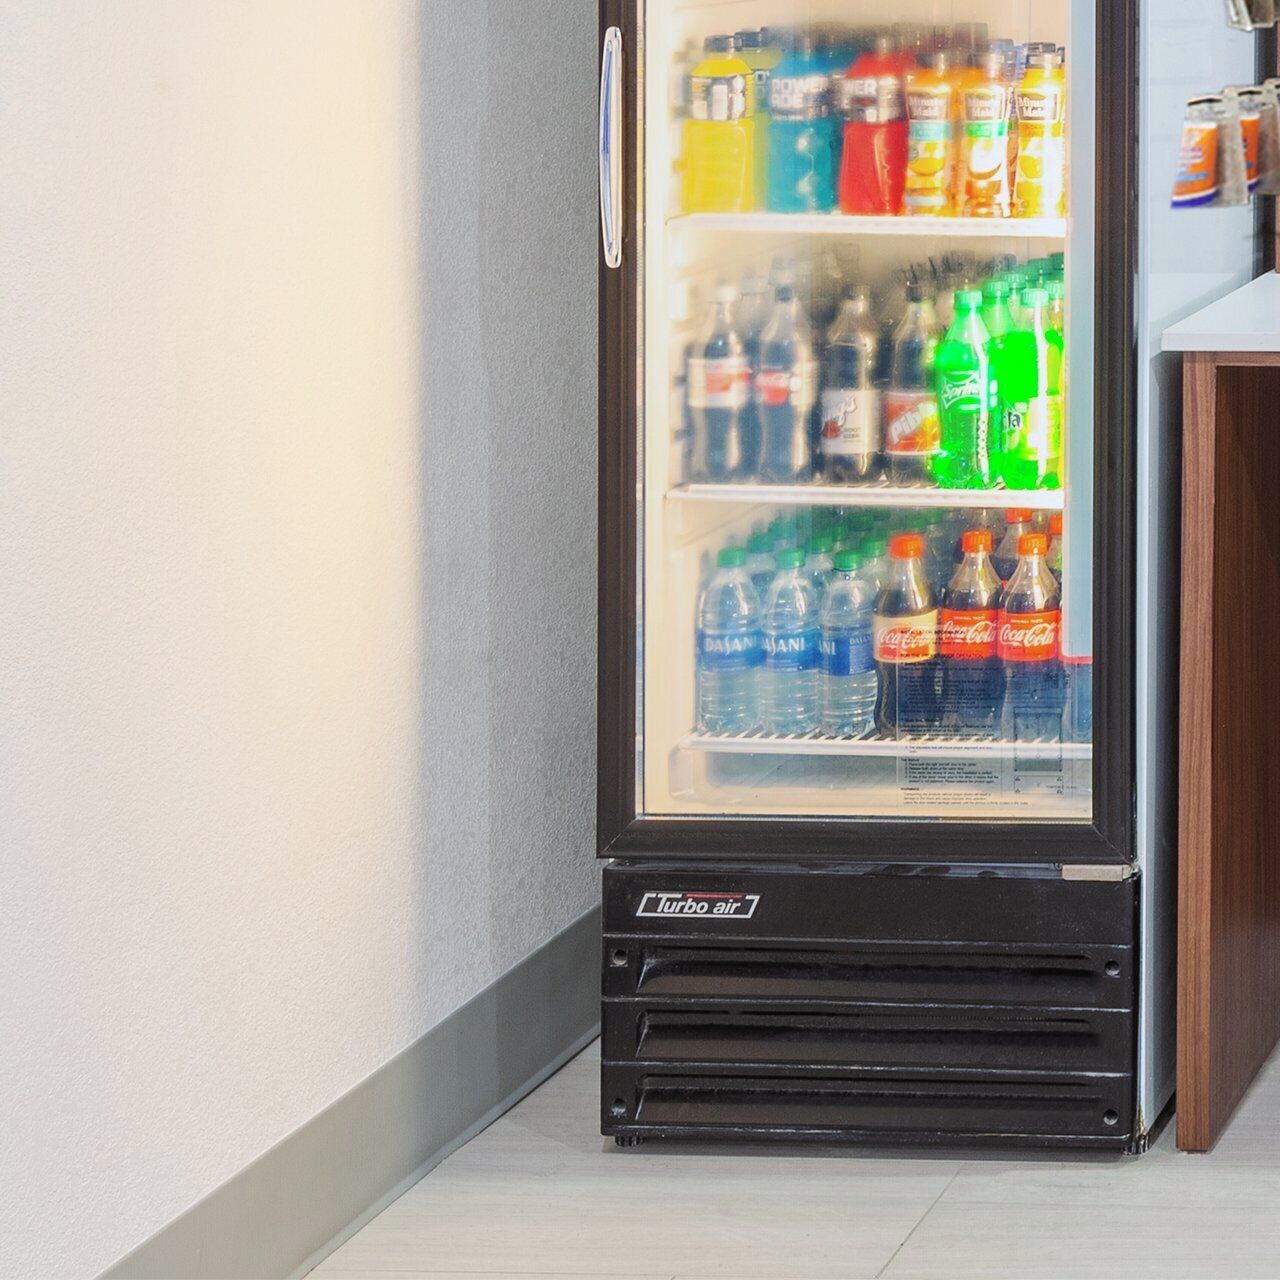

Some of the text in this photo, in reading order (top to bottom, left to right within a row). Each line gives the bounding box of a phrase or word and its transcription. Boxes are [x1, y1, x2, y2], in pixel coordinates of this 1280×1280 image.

[943, 380, 983, 399] Sprit
[761, 634, 806, 655] ASANI
[999, 623, 1055, 647] Coca-Cola
[704, 635, 754, 657] DASAN
[656, 893, 741, 914] Turbo air
